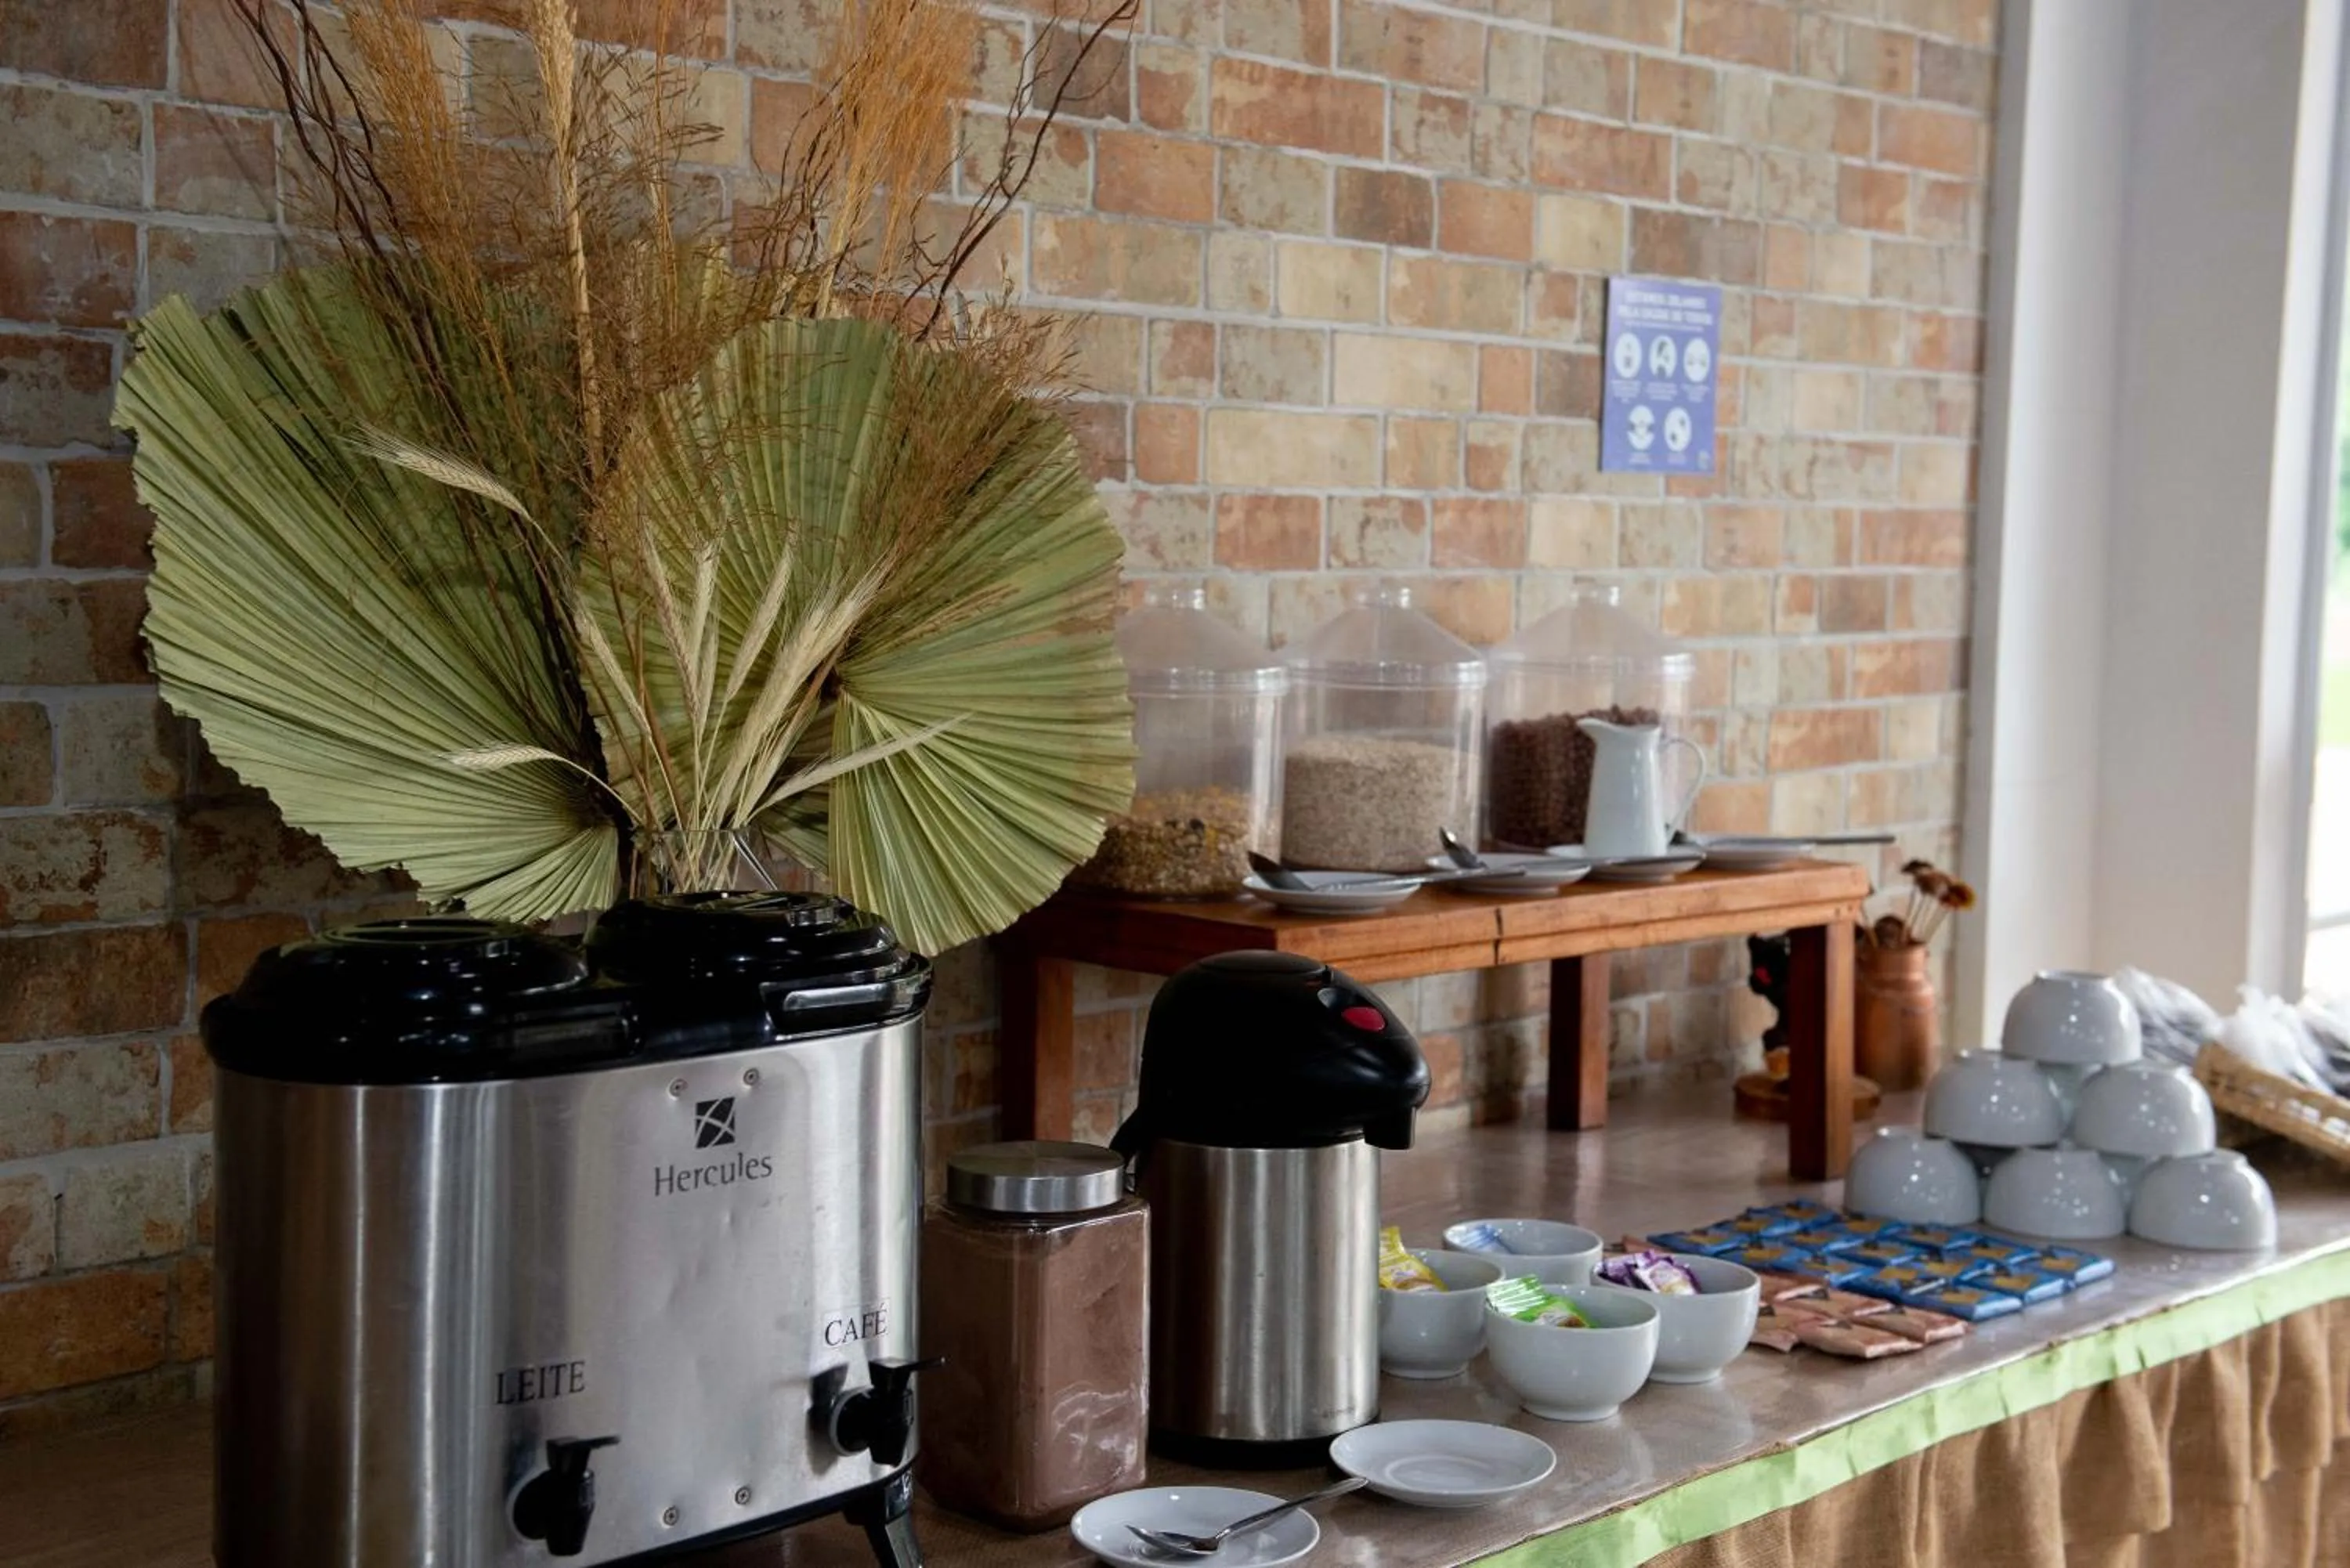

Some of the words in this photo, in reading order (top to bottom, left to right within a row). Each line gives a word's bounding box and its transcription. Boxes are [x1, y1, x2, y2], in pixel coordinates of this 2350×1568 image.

[654, 1151, 772, 1197] Hercules
[824, 1302, 888, 1346] CAFÉ
[495, 1361, 586, 1405] LEITE
